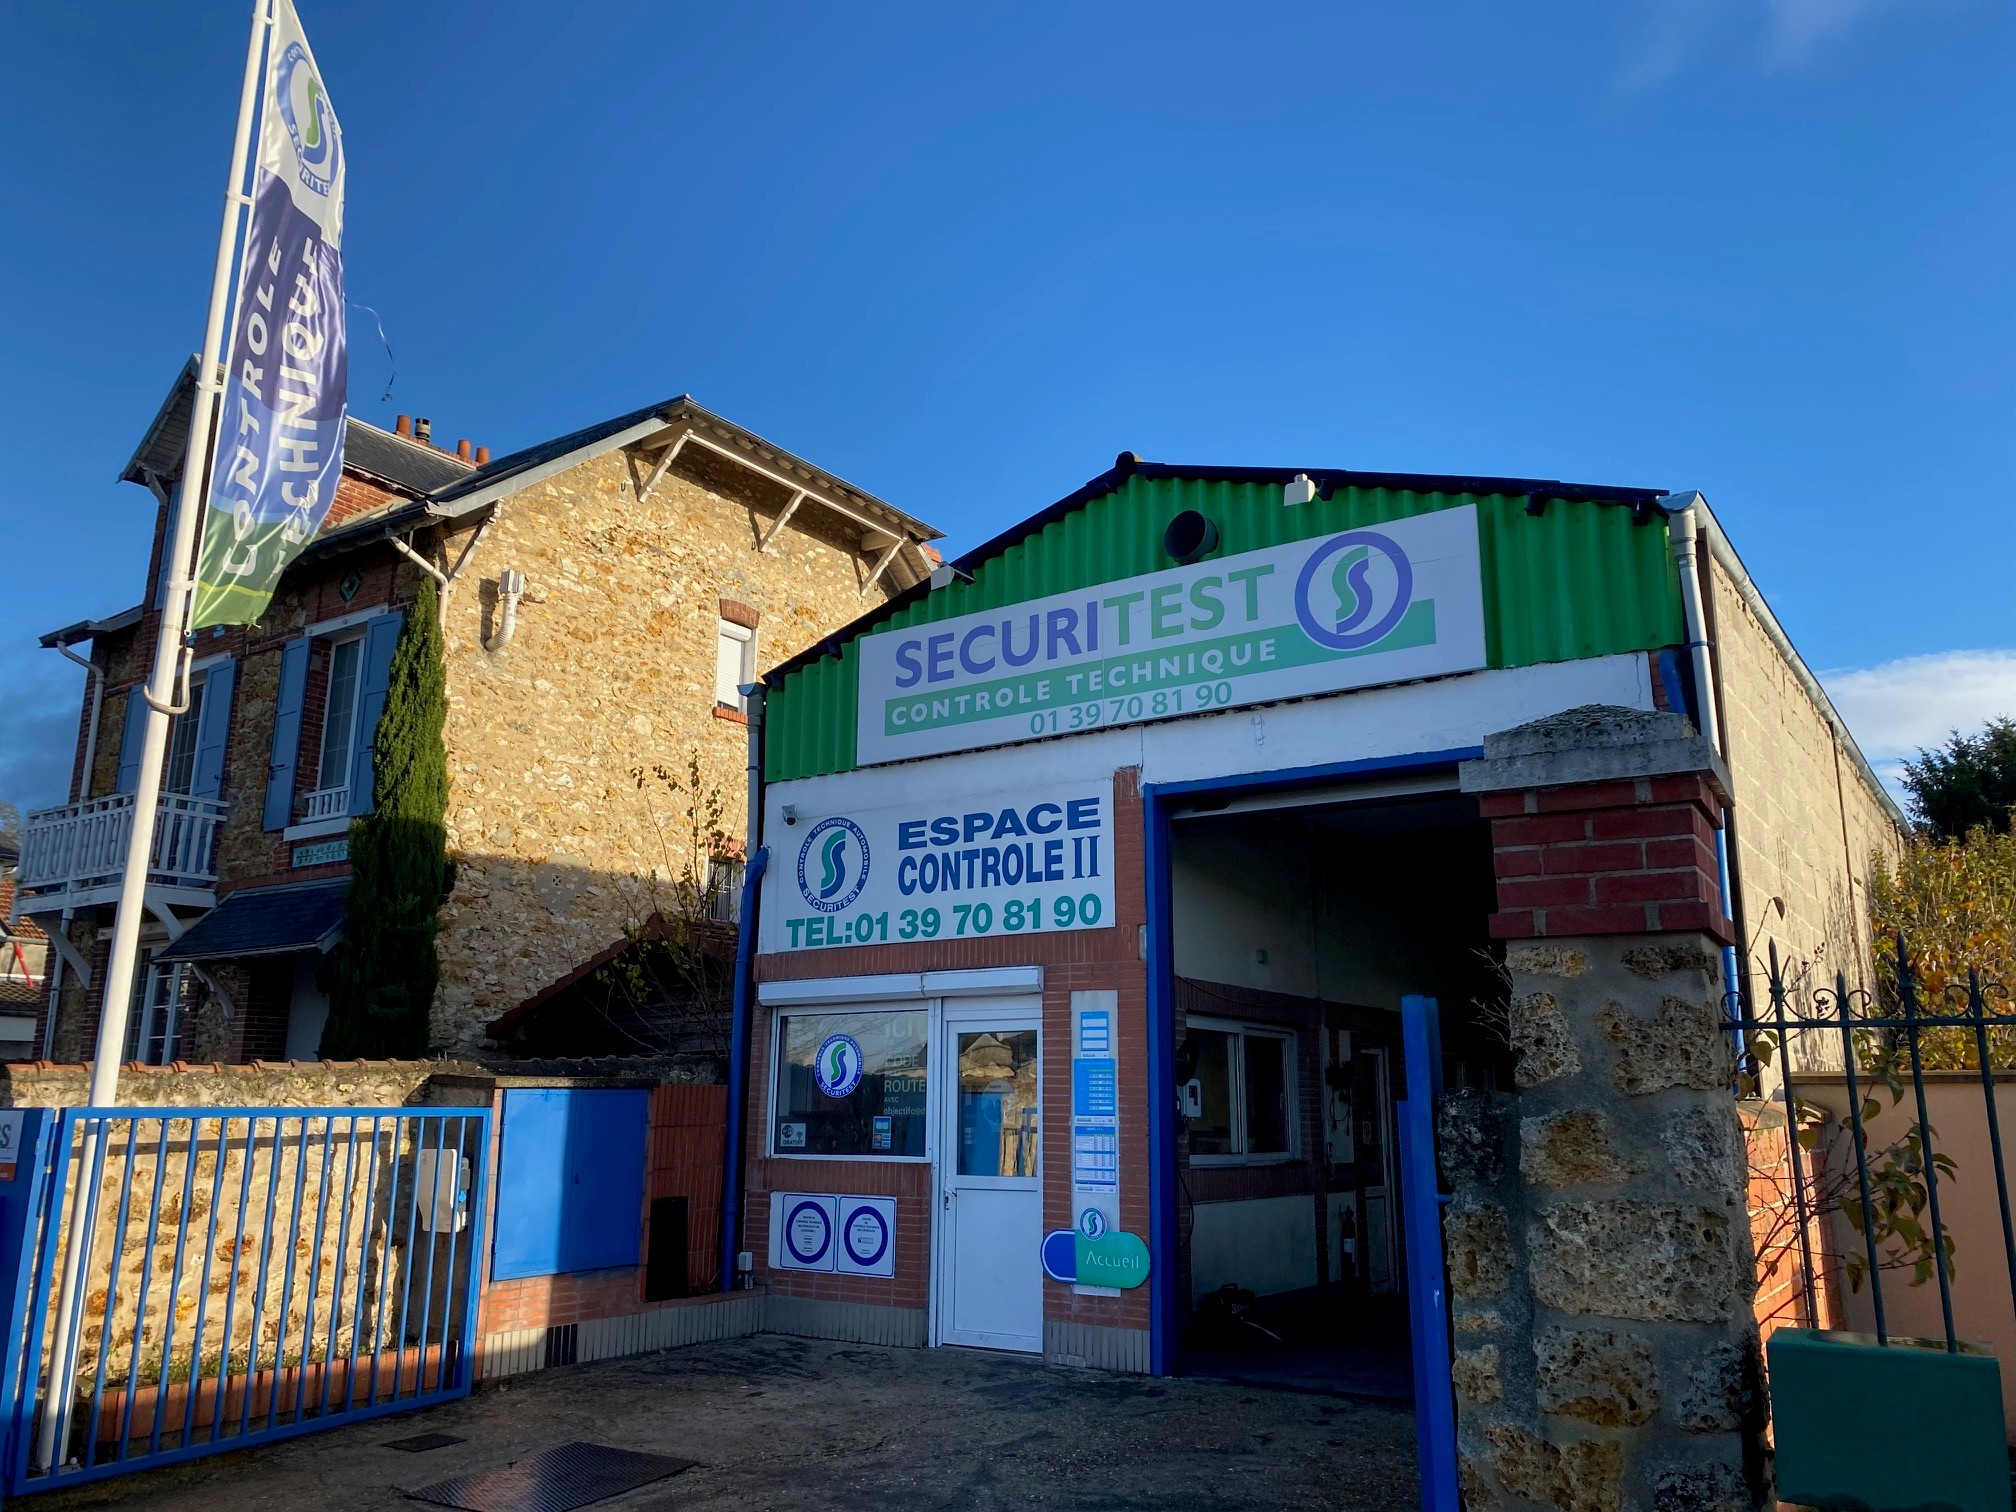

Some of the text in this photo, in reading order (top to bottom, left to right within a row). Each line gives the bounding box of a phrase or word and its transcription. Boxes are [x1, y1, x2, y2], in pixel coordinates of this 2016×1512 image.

[222, 235, 282, 577] CONTROLE
[896, 564, 1275, 688] SECURITEST
[891, 638, 1277, 726] CONTROLE TECHNIQUE
[1030, 681, 1232, 735] 01 39 70 81 90
[898, 797, 1101, 851] ESPACE
[798, 819, 869, 884] CONTROLE TECHNIQUE AUTOMOBILE
[898, 835, 1101, 896] CONTROLE II
[802, 886, 860, 912] SECURITEST
[899, 907, 941, 939] 39
[953, 902, 993, 935] 70
[1002, 898, 1042, 931] 81
[1053, 893, 1102, 928] 90
[883, 1079, 926, 1093] ROUTE
[885, 1055, 919, 1067] CODE
[820, 1081, 856, 1096] SECURITEST
[883, 1096, 900, 1104] AVEC
[1086, 1250, 1139, 1269] Accueil
